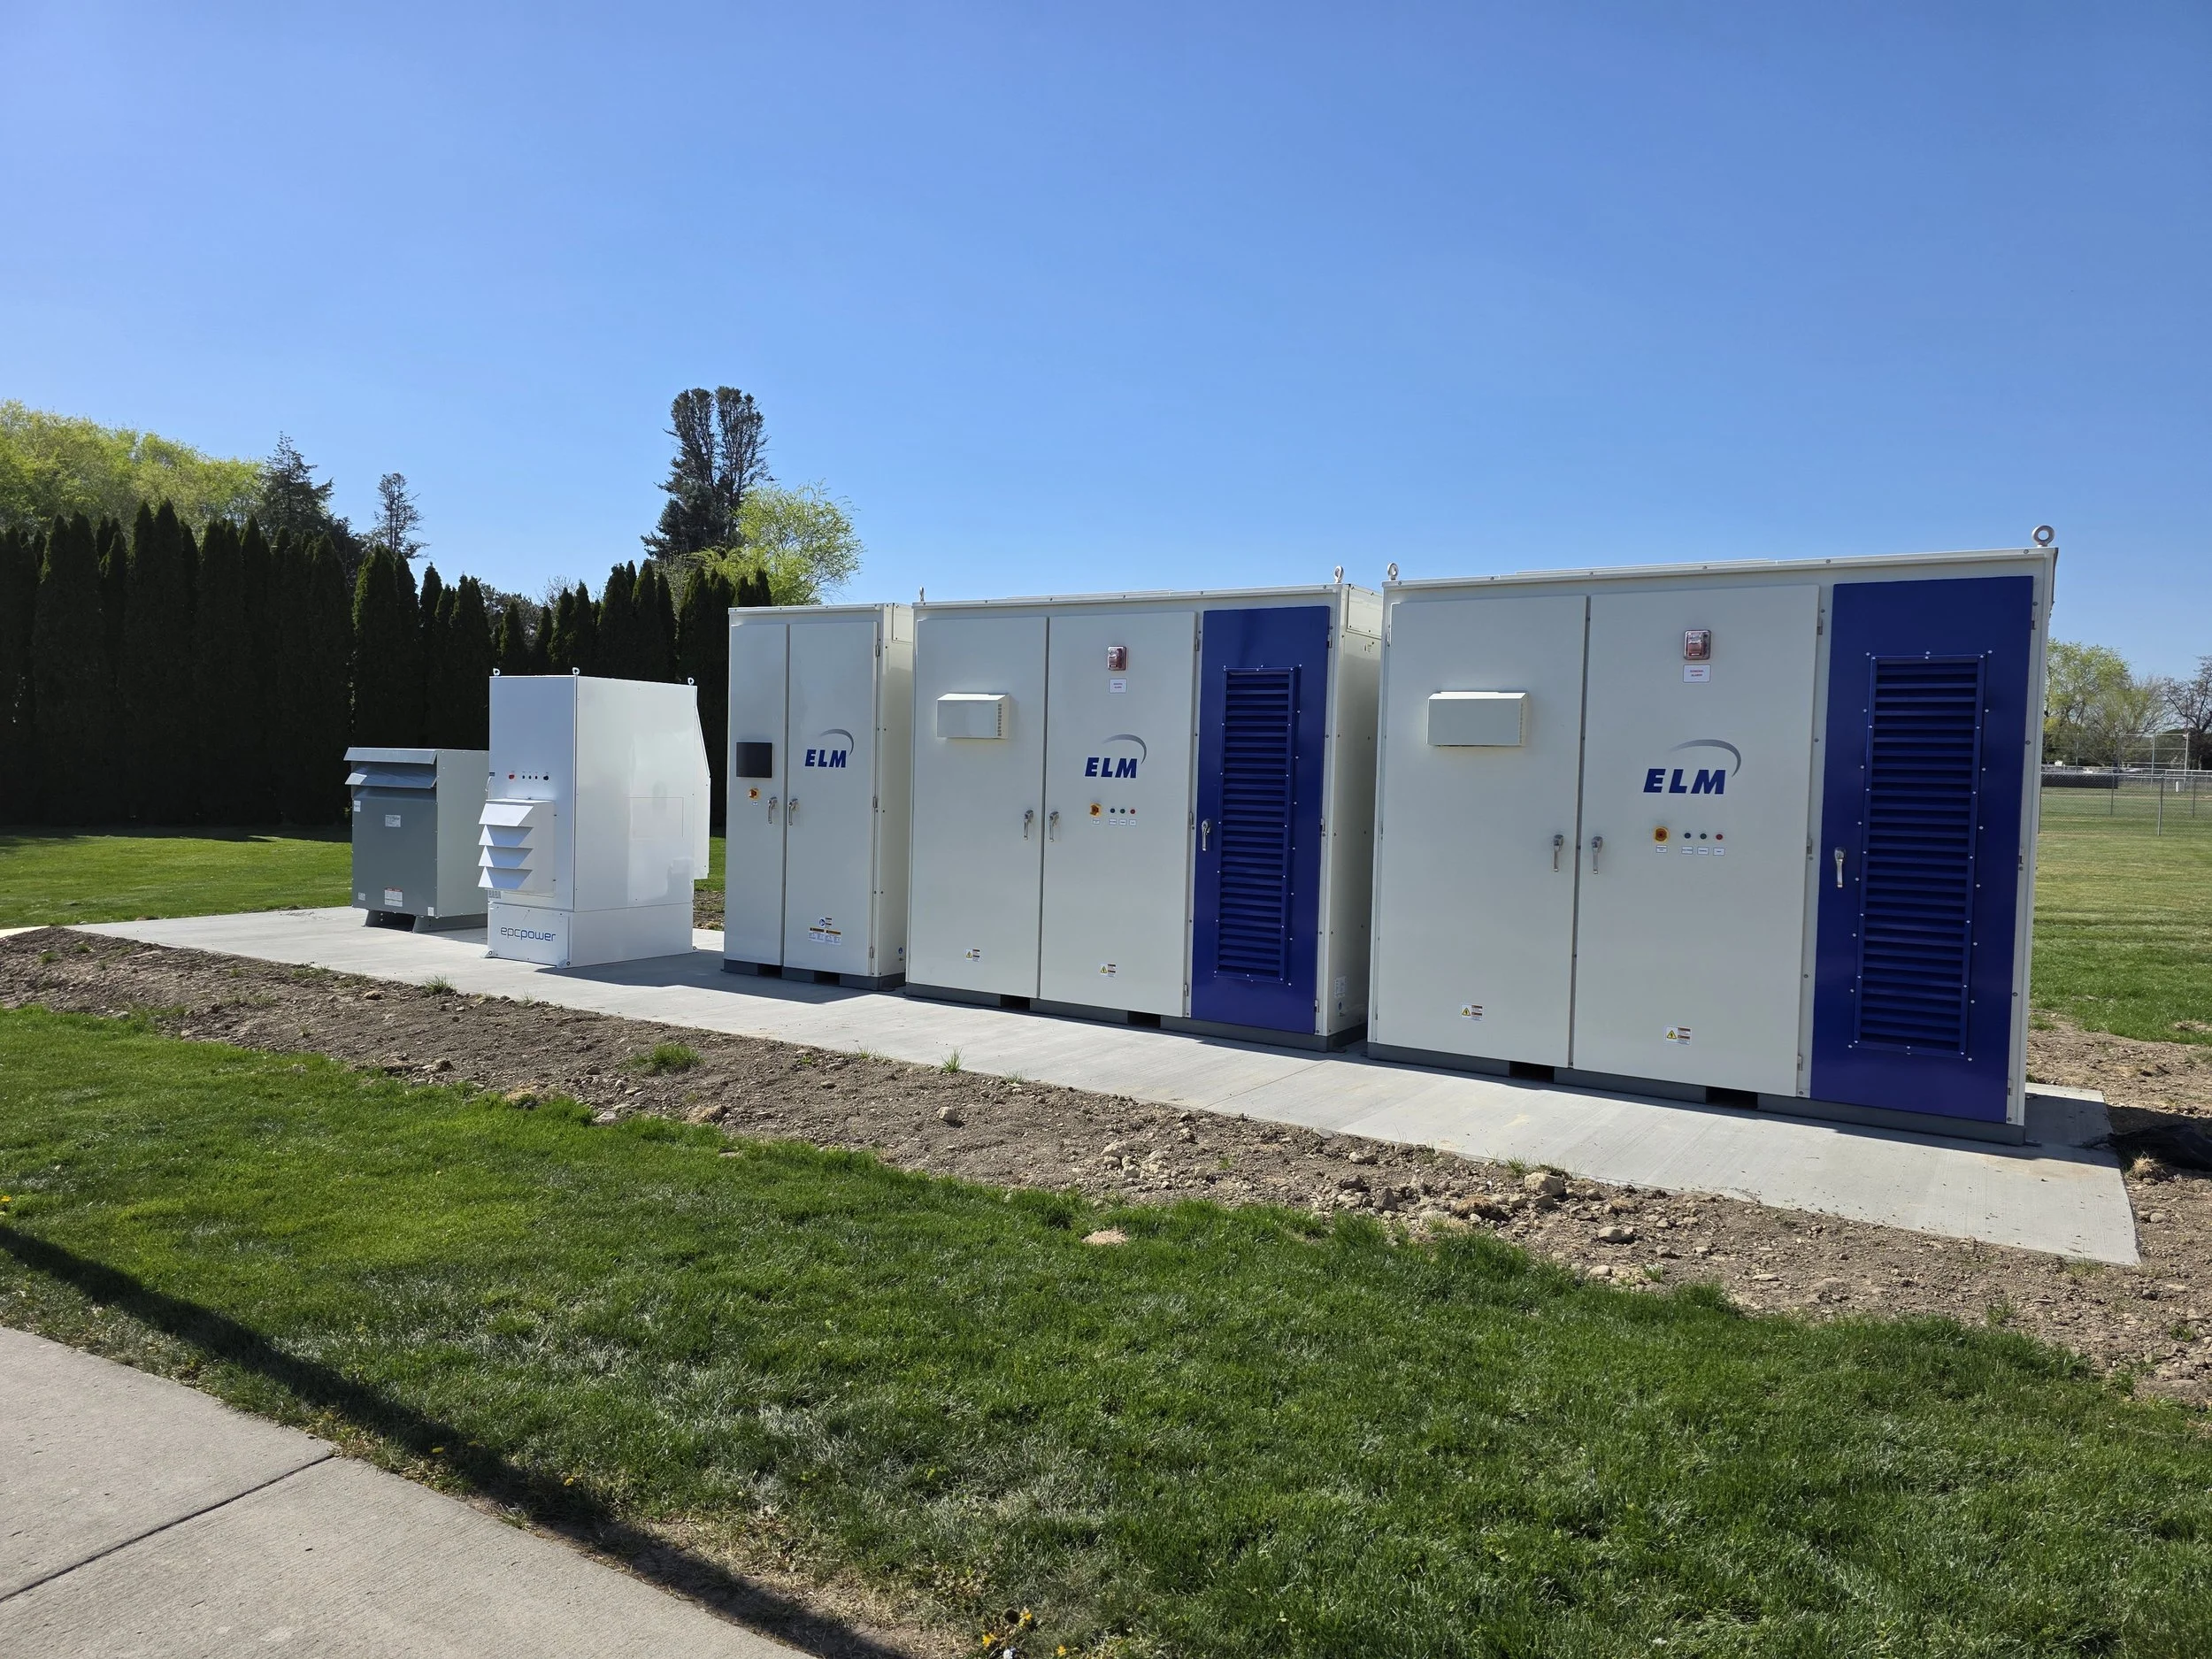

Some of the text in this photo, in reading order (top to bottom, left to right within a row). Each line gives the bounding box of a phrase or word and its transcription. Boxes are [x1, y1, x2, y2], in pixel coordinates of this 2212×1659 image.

[804, 749, 847, 768] ELM
[1084, 757, 1138, 779] ELM
[1643, 768, 1726, 795] ELM
[500, 926, 557, 941] epcpower
